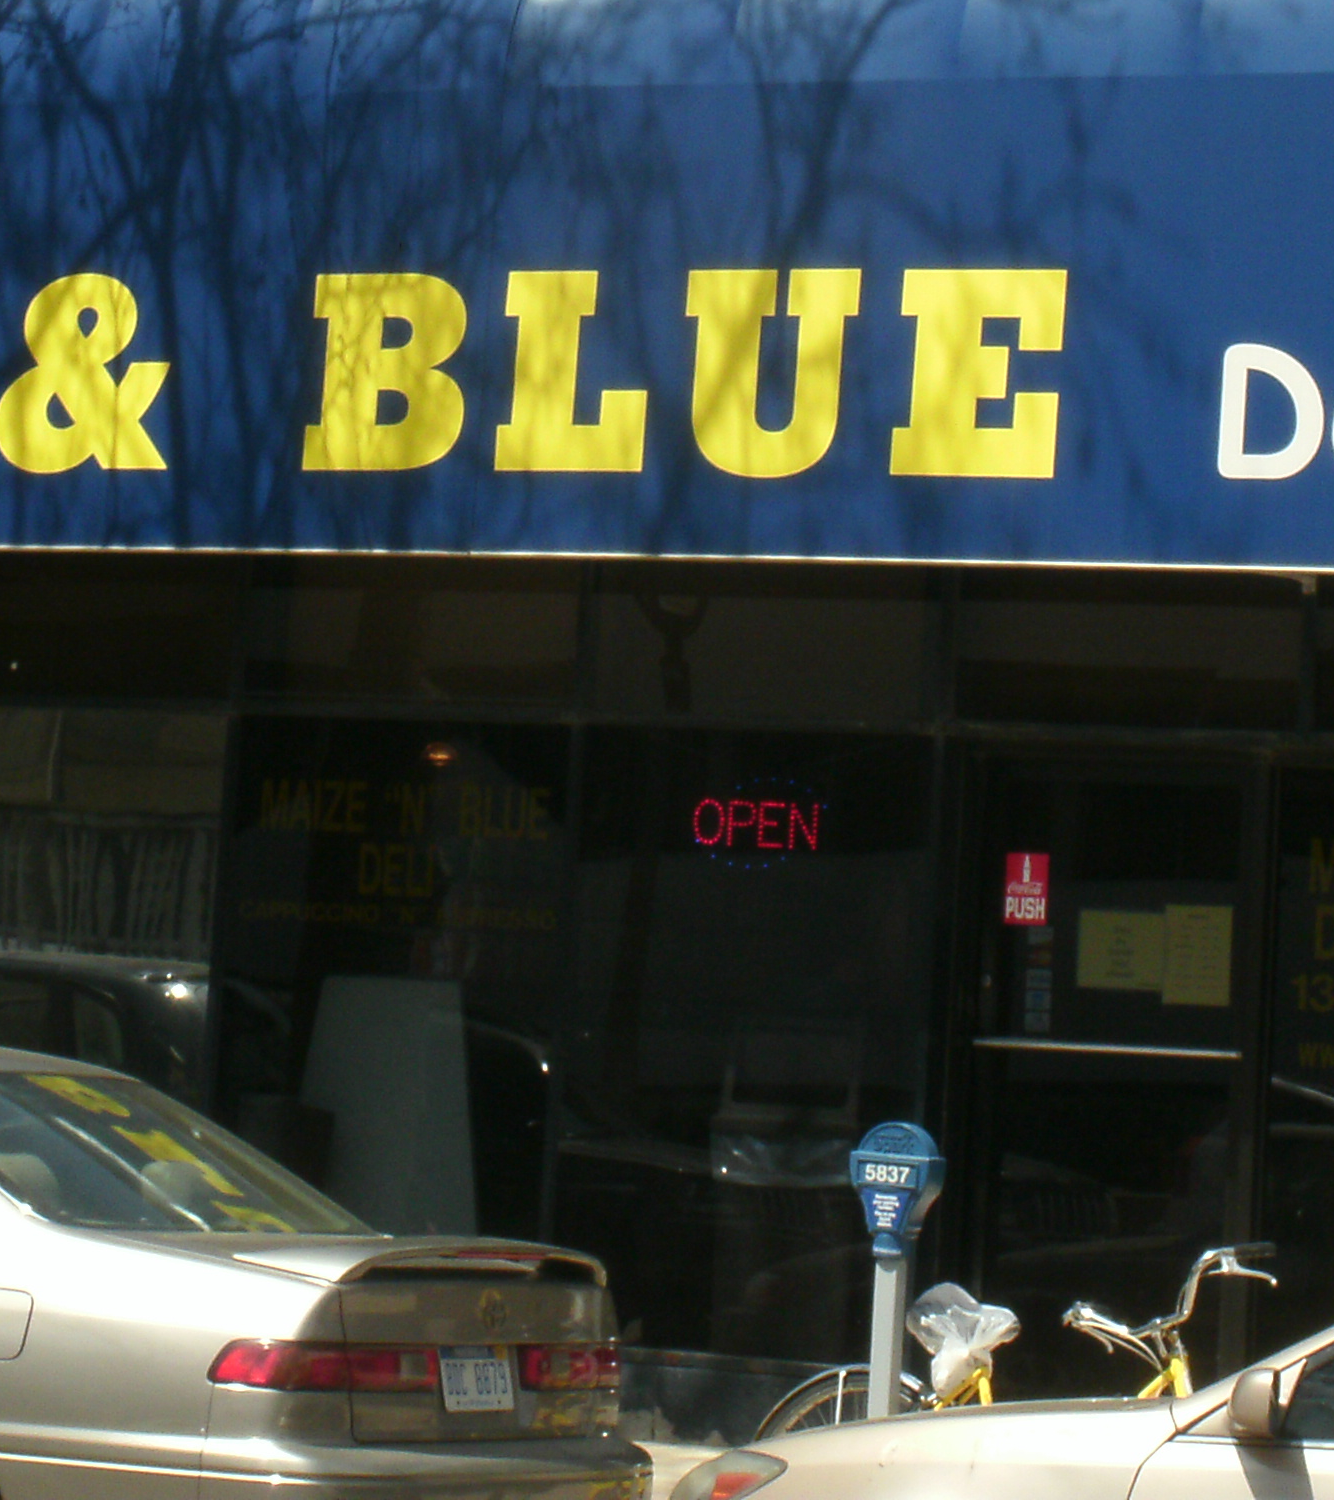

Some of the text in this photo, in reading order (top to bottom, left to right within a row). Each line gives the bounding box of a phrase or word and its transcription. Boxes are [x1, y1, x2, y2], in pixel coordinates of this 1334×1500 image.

[301, 267, 1068, 479] BLUE
[259, 777, 369, 834] MAIZE
[459, 781, 551, 841] BLUE
[693, 798, 819, 850] OPEN
[358, 843, 435, 897] DELI
[1005, 896, 1046, 920] PUSH
[865, 1164, 911, 1184] 5837
